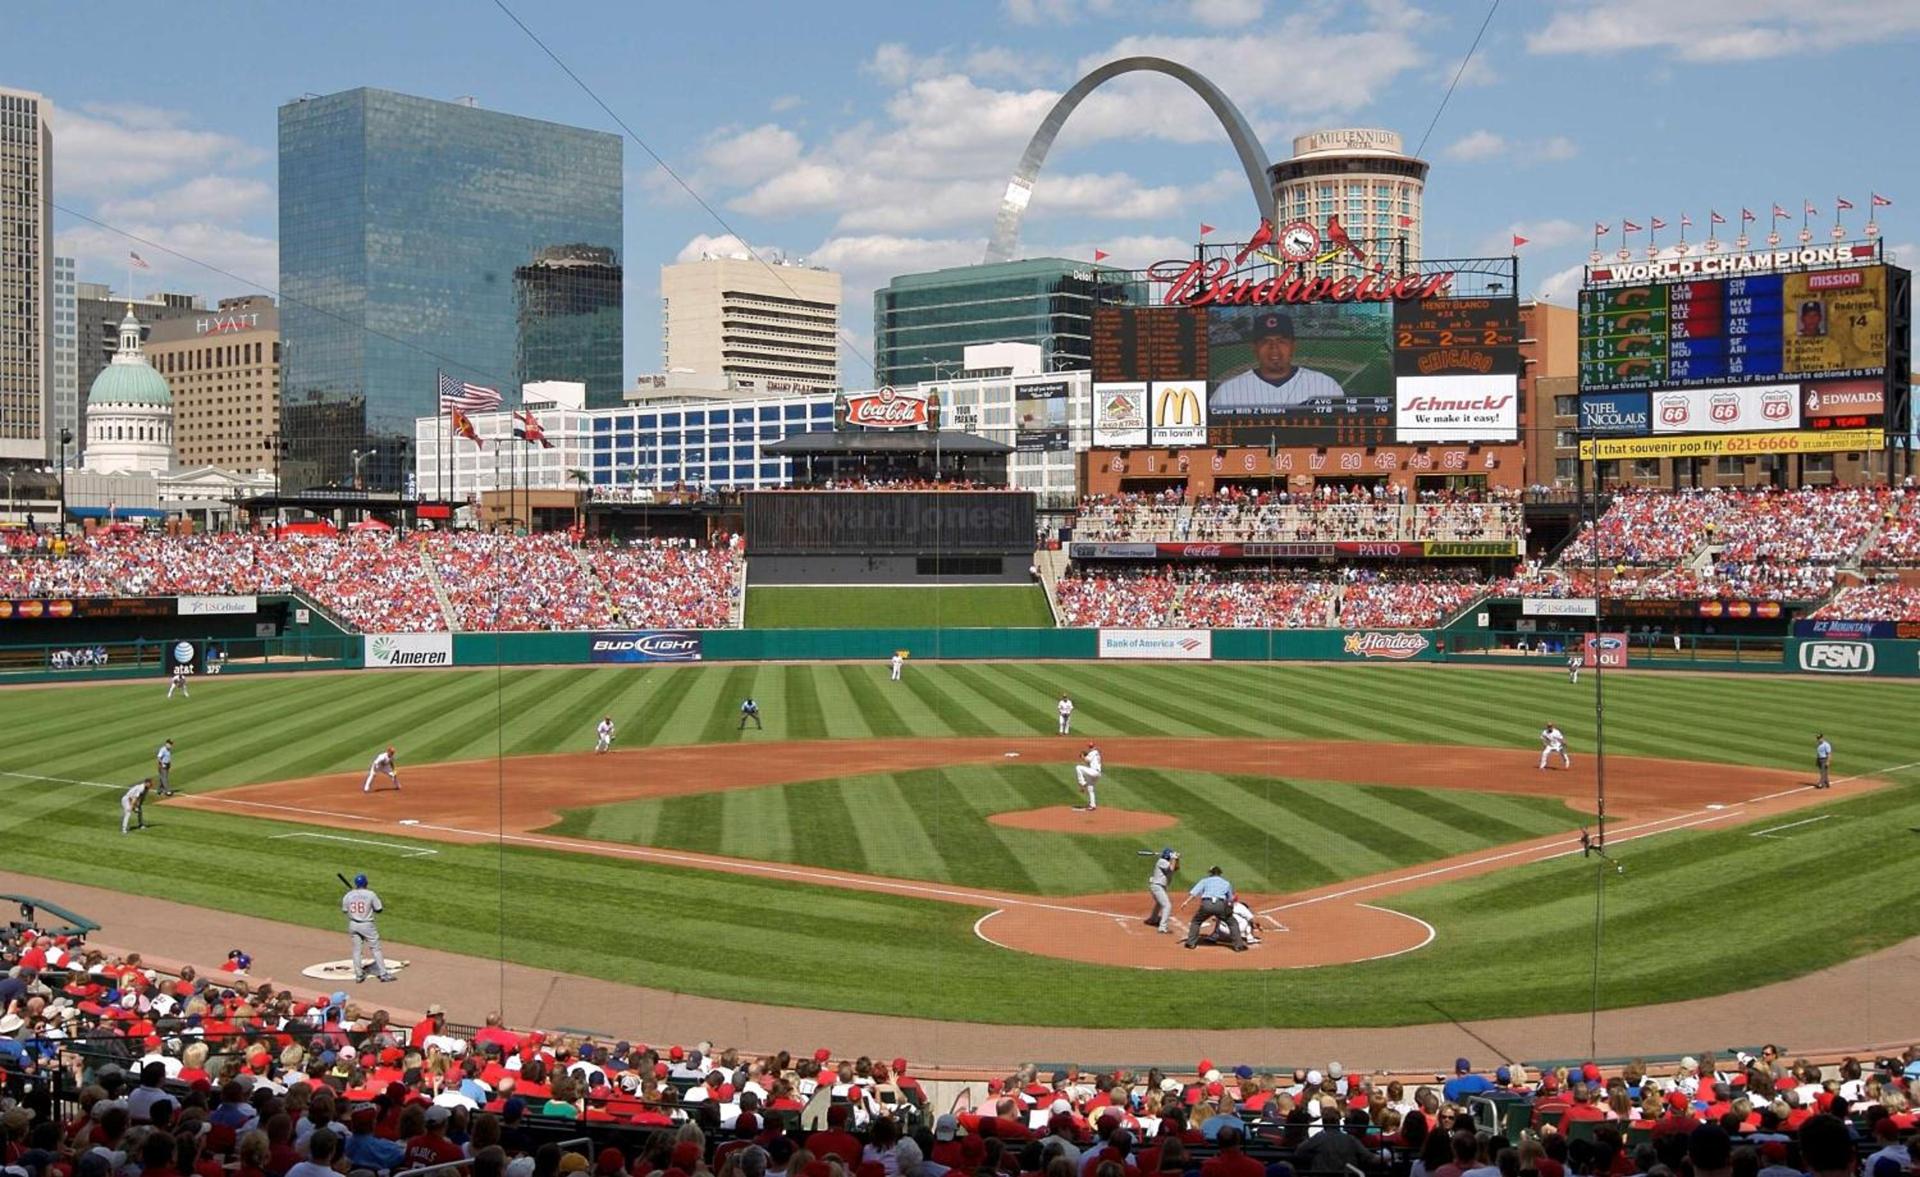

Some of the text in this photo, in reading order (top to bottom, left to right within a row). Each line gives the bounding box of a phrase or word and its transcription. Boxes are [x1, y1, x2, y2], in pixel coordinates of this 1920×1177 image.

[1319, 131, 1394, 144] MILLENNIUM
[1610, 247, 1854, 282] WORLD CHAMPIONS
[1147, 258, 1455, 304] Budweiser
[1671, 285, 1690, 293] LAA
[1730, 288, 1745, 296] PIT
[1671, 292, 1692, 301] CHW
[1422, 300, 1490, 310] HENRY BLANCO
[1598, 303, 1604, 312] 3
[1730, 306, 1751, 315] WAS
[1671, 310, 1688, 319] CLE
[196, 312, 260, 333] HYATT
[1671, 323, 1684, 331] KC
[1730, 318, 1748, 327] ATL
[1850, 315, 1868, 328] 14
[1671, 330, 1690, 339] SEA
[1730, 326, 1748, 334] COL
[1399, 332, 1413, 347] 2
[1440, 330, 1453, 346] 2
[1484, 330, 1498, 345] 2
[1597, 339, 1604, 348] 0
[1730, 338, 1742, 346] SF
[1671, 341, 1687, 349] MIL
[1730, 345, 1747, 354] ARI
[1597, 351, 1604, 359] 0
[1671, 348, 1691, 357] HOU
[1417, 349, 1494, 374] CHICAGO
[1671, 360, 1690, 369] FLA
[1730, 357, 1742, 365] LA
[1597, 363, 1604, 371] 0
[1671, 367, 1687, 376] PHI
[1730, 364, 1743, 373] SD
[1580, 384, 1609, 392] Toronto
[1611, 381, 1647, 390] activates
[1705, 376, 1725, 384] from
[1778, 371, 1812, 381] Roberts
[1814, 368, 1851, 379] optioned
[1853, 368, 1863, 376] to
[1865, 367, 1885, 376] SYR
[1401, 395, 1513, 411] Schnucks
[1822, 392, 1882, 405] EDWARDS
[858, 400, 919, 421] Coca-Cola
[1375, 405, 1388, 413] 70
[1582, 401, 1618, 415] STIFEL
[1714, 405, 1735, 418] 66
[1766, 403, 1786, 416] 66
[1415, 413, 1500, 424] We make it easy!
[1587, 411, 1647, 426] NICOLAUS
[1664, 408, 1685, 421] 66
[1169, 429, 1195, 438] lovin'
[1197, 429, 1204, 437] it
[1604, 441, 1626, 454] that
[1630, 440, 1677, 453] souvenir
[1680, 442, 1700, 455] pop
[1704, 439, 1722, 452] fly!
[1727, 435, 1799, 451] 621-6666
[1147, 455, 1155, 472] 1
[1211, 455, 1223, 471] 6
[1244, 454, 1256, 470] 9
[1276, 454, 1292, 470] 14
[1309, 453, 1326, 469] 17
[1341, 453, 1362, 469] 20
[1374, 452, 1396, 469] 42
[1409, 452, 1432, 468] 45
[1443, 451, 1465, 468] 85
[908, 507, 1011, 533] Jones
[1358, 543, 1512, 556] PATIO AUTOTIRE
[1813, 621, 1875, 632] ICE MOUNTAIN
[593, 640, 698, 650] BUD LIGHT
[1106, 639, 1175, 648] Bank of America
[1359, 634, 1424, 649] Hardee's
[390, 649, 446, 664] Ameren
[1810, 645, 1863, 668] FSN
[173, 664, 194, 675] at&t
[350, 902, 365, 914] 38
